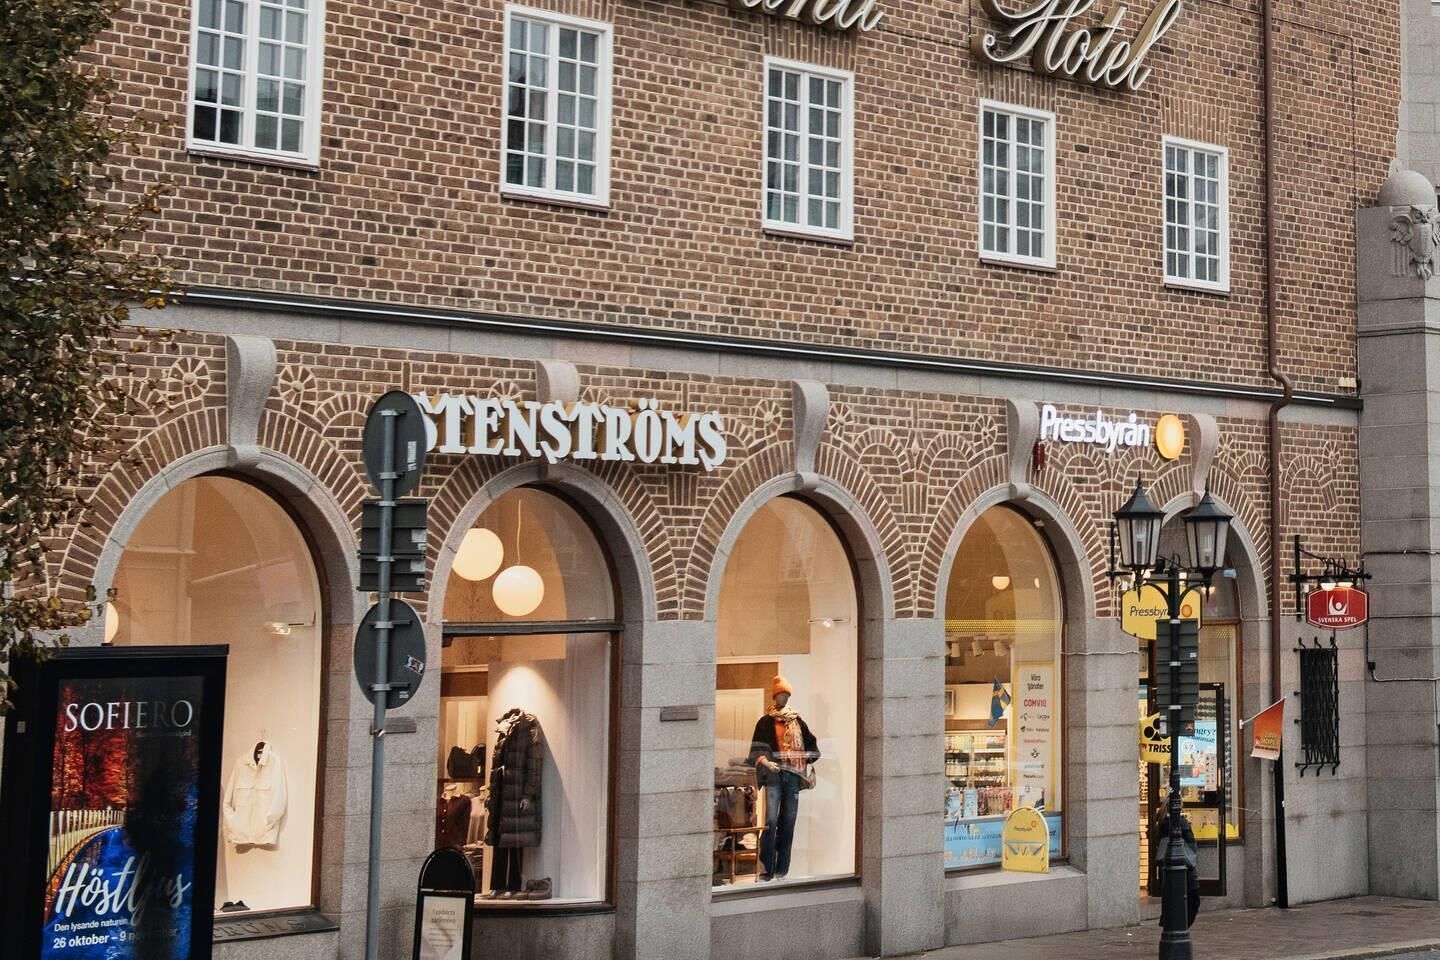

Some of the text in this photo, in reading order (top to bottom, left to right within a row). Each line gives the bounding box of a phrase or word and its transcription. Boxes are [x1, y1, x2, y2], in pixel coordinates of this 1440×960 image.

[1040, 404, 1150, 454] Pressbyrån
[1130, 605, 1169, 619] Pressbyr
[64, 699, 194, 733] SOFIERO
[1148, 743, 1171, 753] TRISS
[54, 922, 70, 932] Den
[70, 919, 100, 932] lysande
[53, 937, 67, 949] 26
[68, 933, 109, 948] oktober
[119, 930, 126, 942] 9
